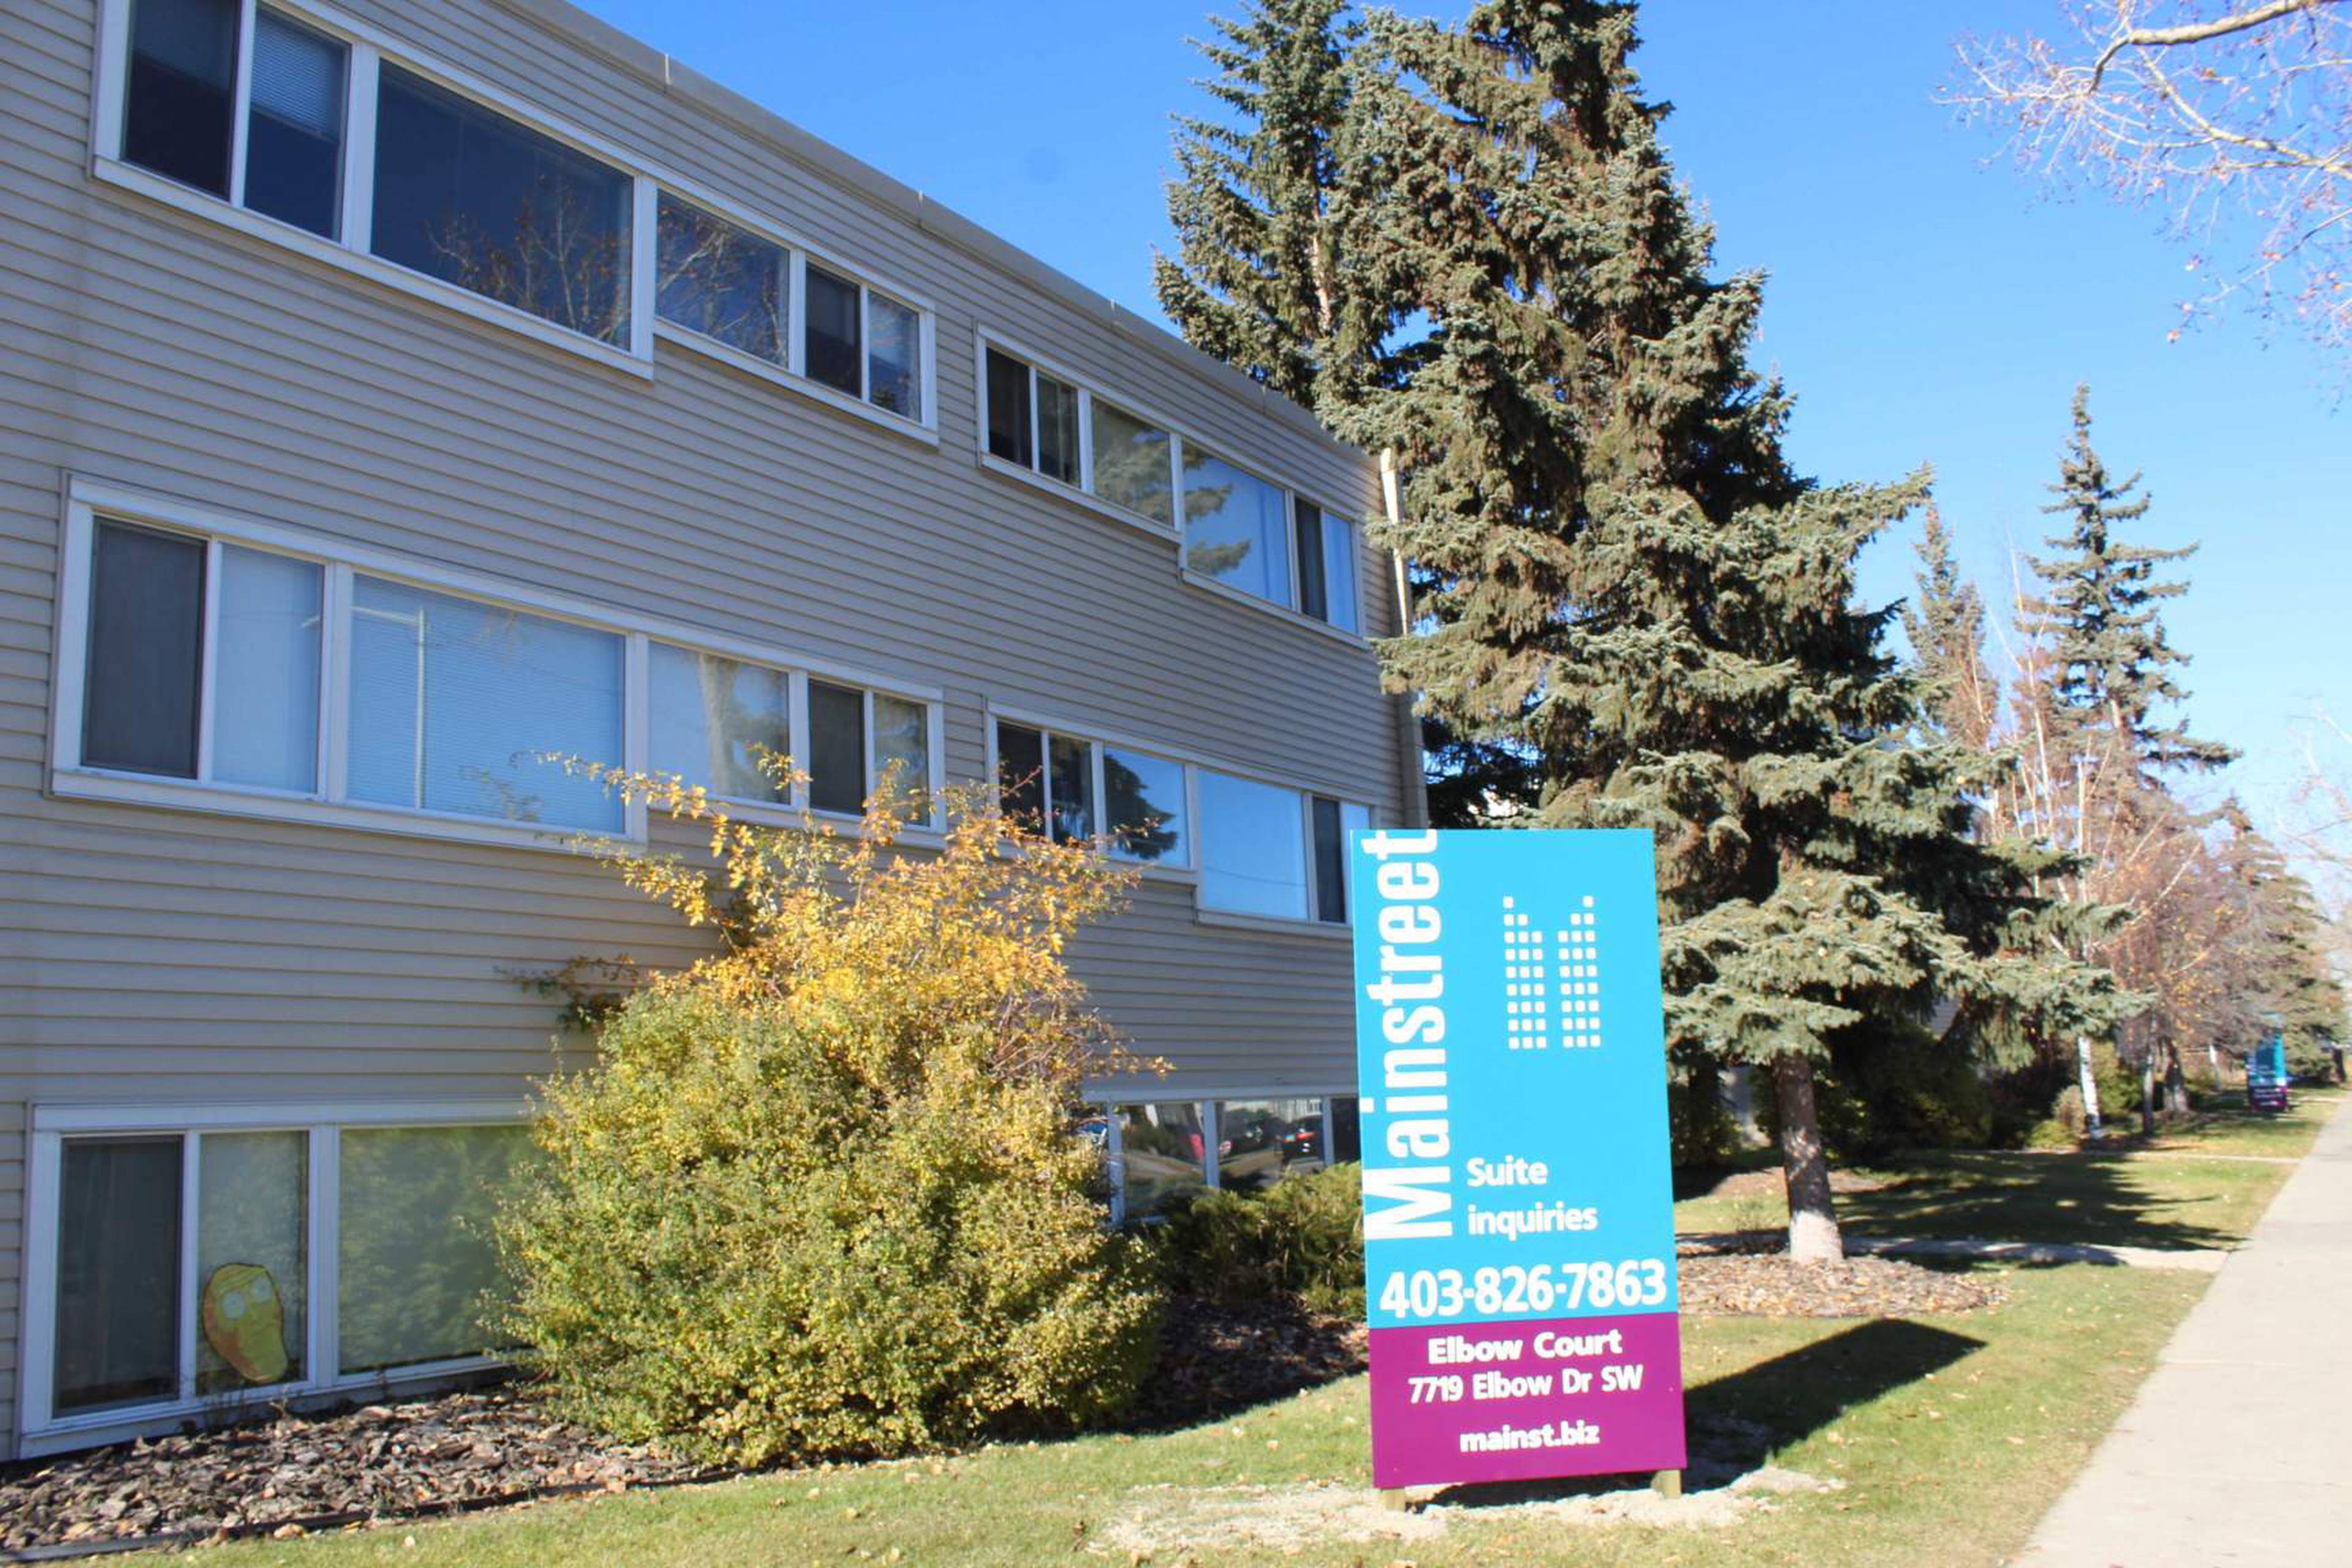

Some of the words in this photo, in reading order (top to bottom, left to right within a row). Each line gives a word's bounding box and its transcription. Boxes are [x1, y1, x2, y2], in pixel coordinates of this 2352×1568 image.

[1359, 829, 1453, 1240] Mainstreet
[1466, 1155, 1548, 1186] Suite
[1468, 1201, 1598, 1241] inquiries
[1379, 1259, 1667, 1318] 403-826-7863
[1428, 1335, 1524, 1365] Elbow
[1533, 1328, 1623, 1359] Court
[1408, 1375, 1464, 1403] 7719
[1472, 1370, 1553, 1400] Elbow
[1561, 1368, 1593, 1395] Dr
[1600, 1363, 1644, 1392] SW
[1459, 1419, 1600, 1453] mainst.biz
